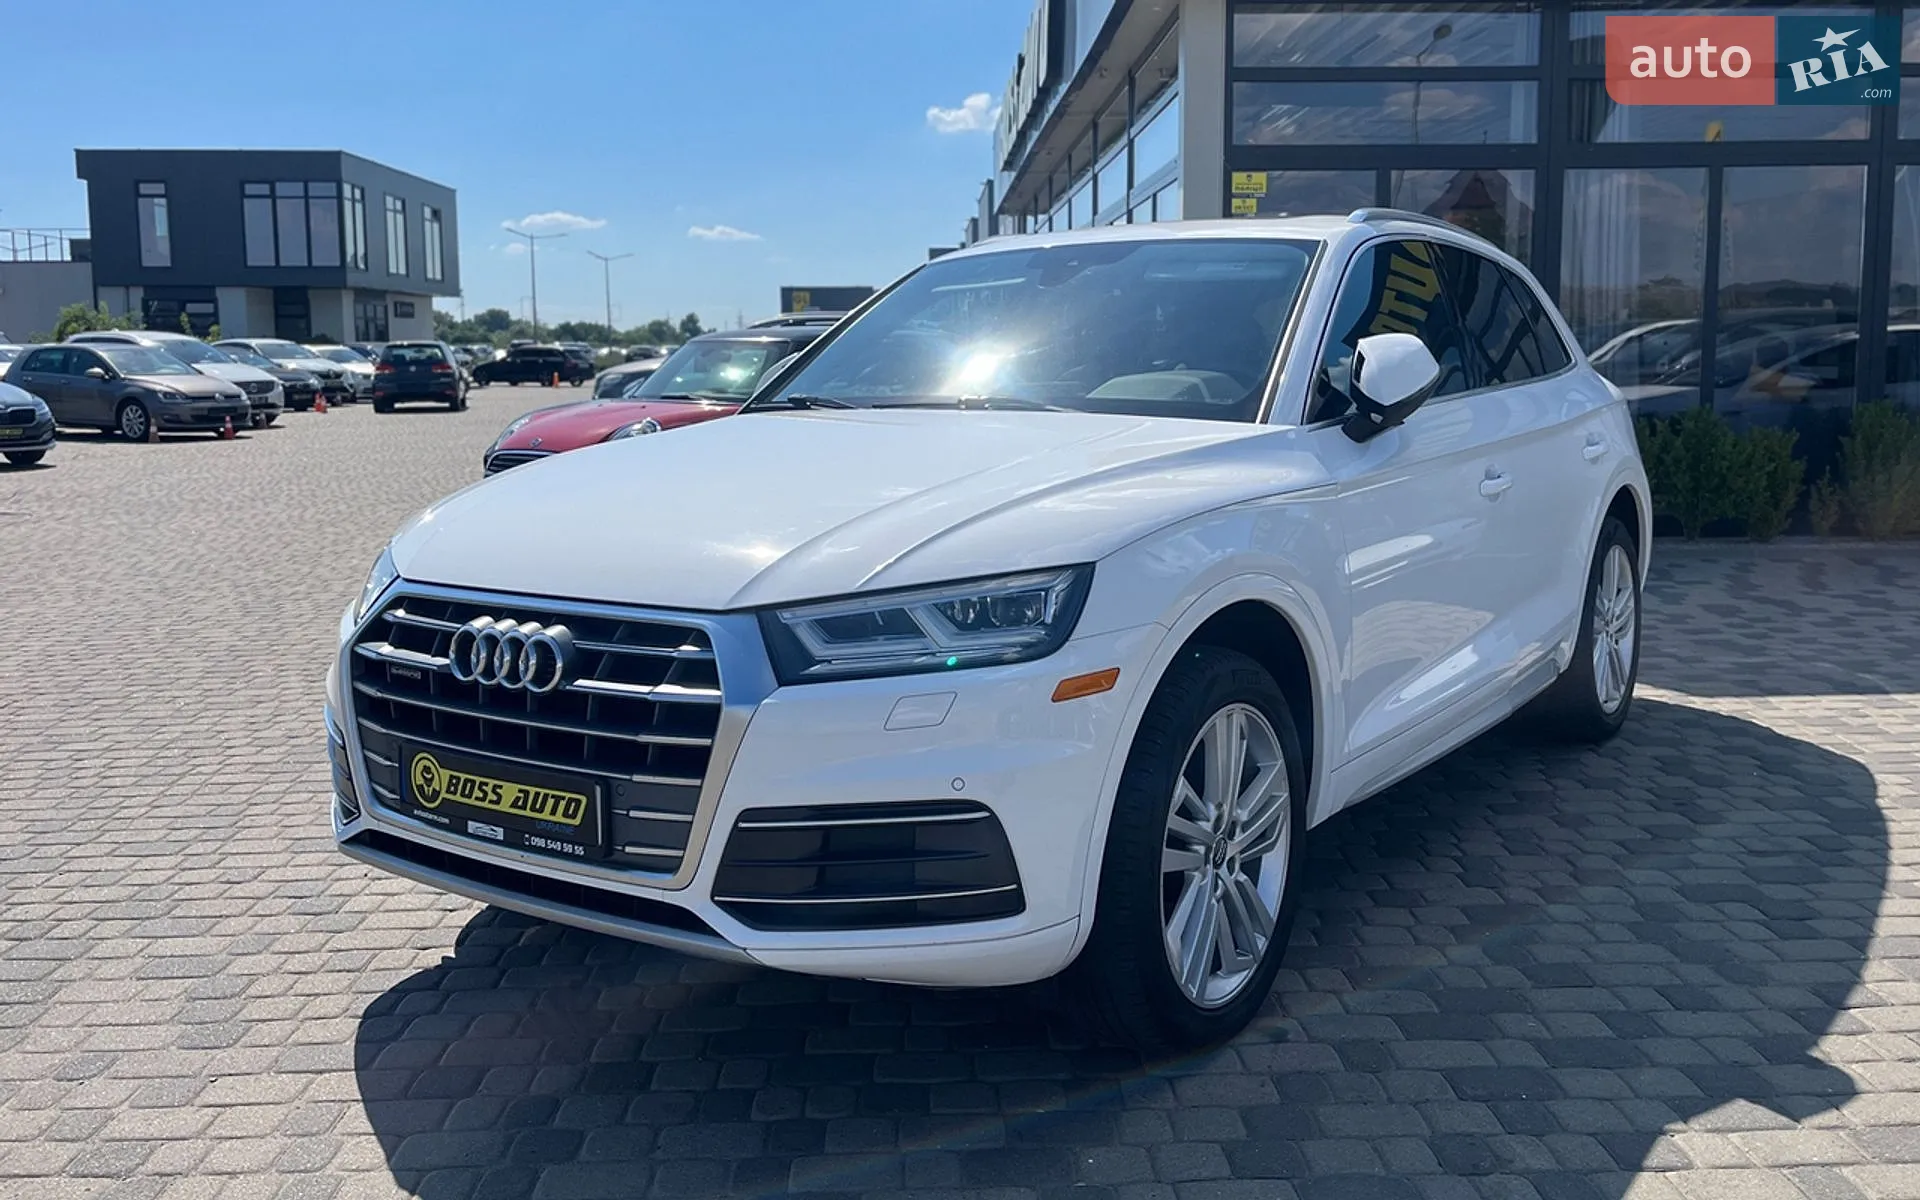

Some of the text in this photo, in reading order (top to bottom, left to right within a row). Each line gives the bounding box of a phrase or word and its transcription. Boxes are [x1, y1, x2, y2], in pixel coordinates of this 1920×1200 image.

[445, 774, 582, 820] BOSS AUTO
[531, 836, 546, 848] 098
